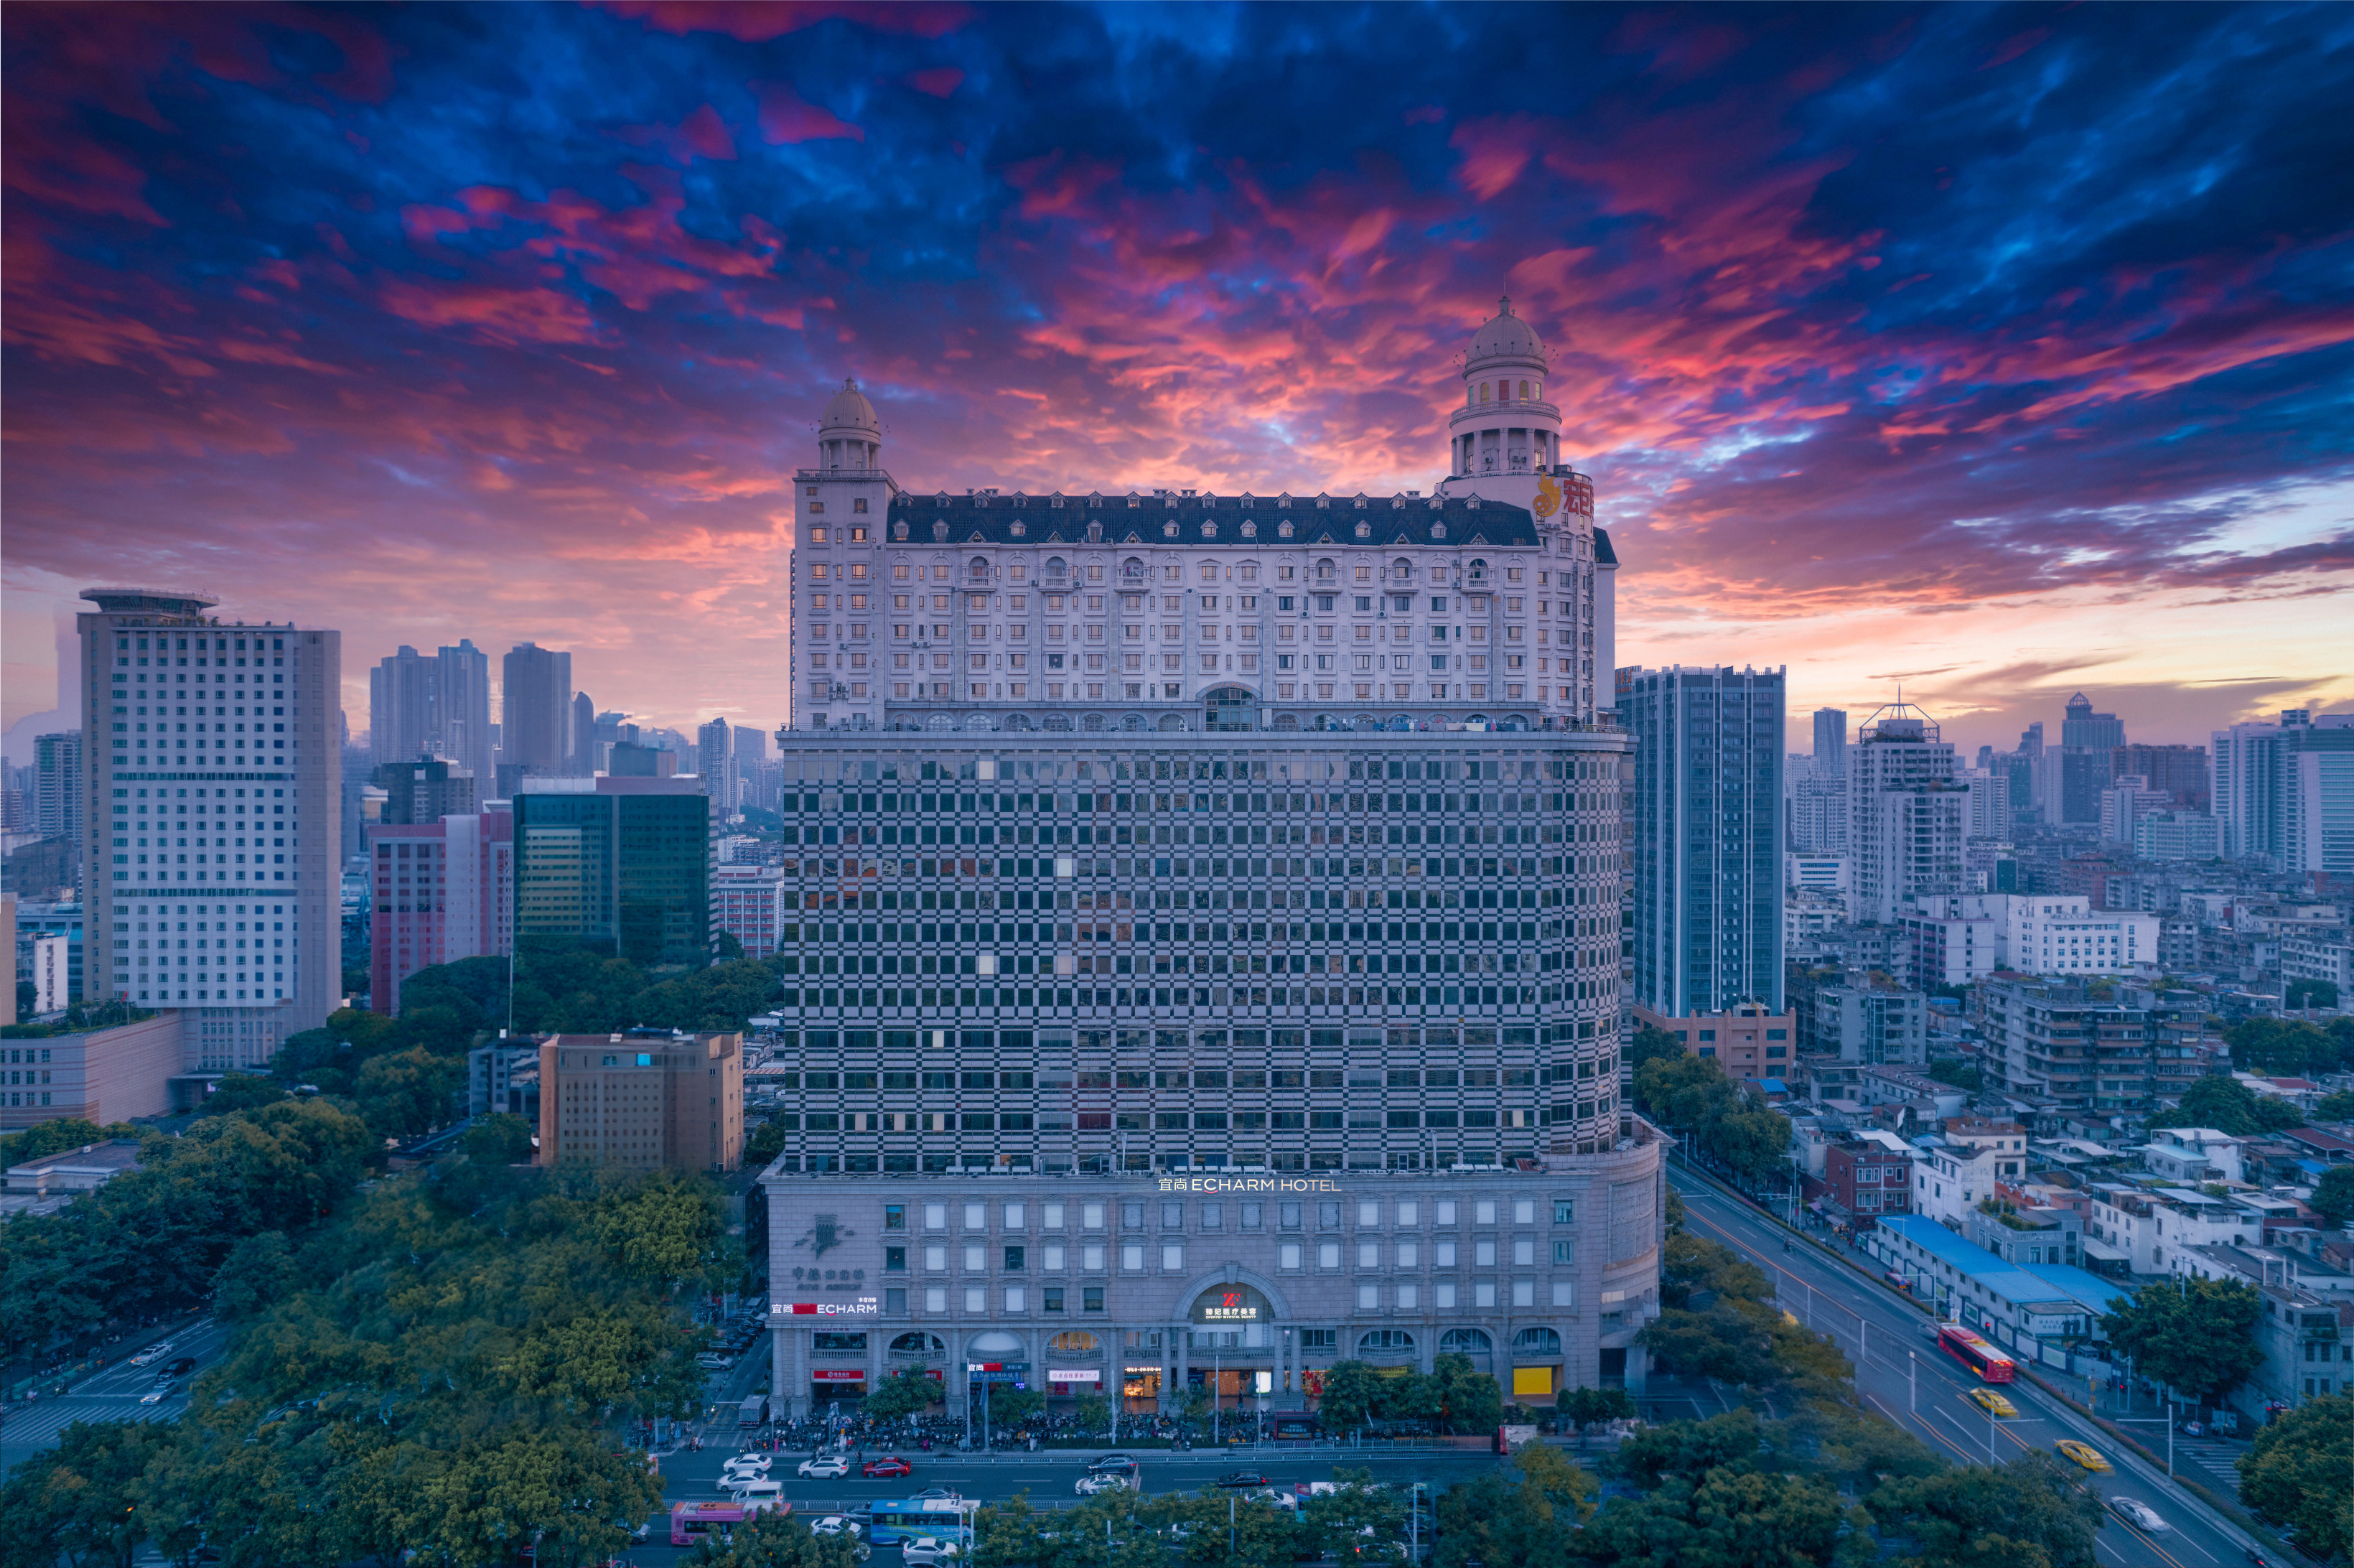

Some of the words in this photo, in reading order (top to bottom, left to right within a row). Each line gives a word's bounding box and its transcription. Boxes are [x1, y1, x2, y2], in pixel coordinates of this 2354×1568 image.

[1159, 1178, 1187, 1191] 宜尚
[1192, 1178, 1274, 1192] ECHARM
[1281, 1180, 1342, 1192] HOTEL
[772, 1304, 793, 1314] 宜尚
[817, 1305, 877, 1314] ECHARM
